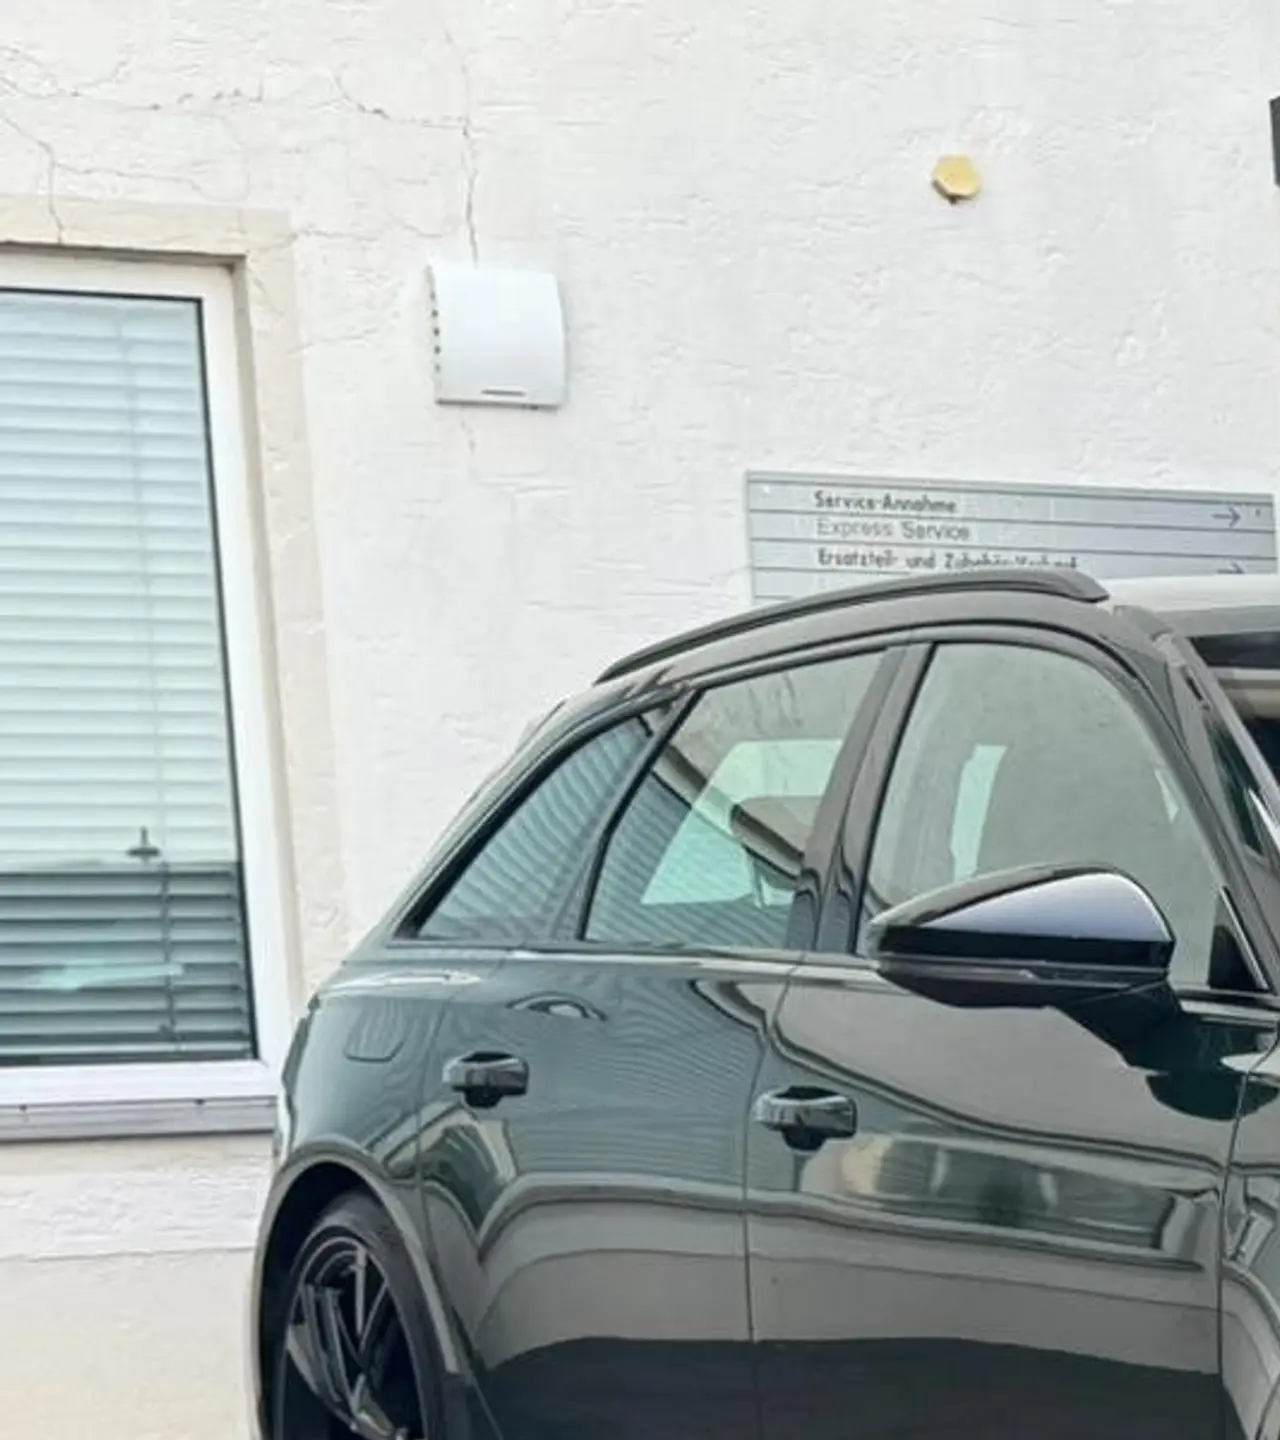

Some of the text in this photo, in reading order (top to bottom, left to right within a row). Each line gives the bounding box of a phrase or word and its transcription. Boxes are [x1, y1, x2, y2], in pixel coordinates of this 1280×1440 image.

[816, 517, 970, 540] Express Service
[905, 550, 936, 569] und
